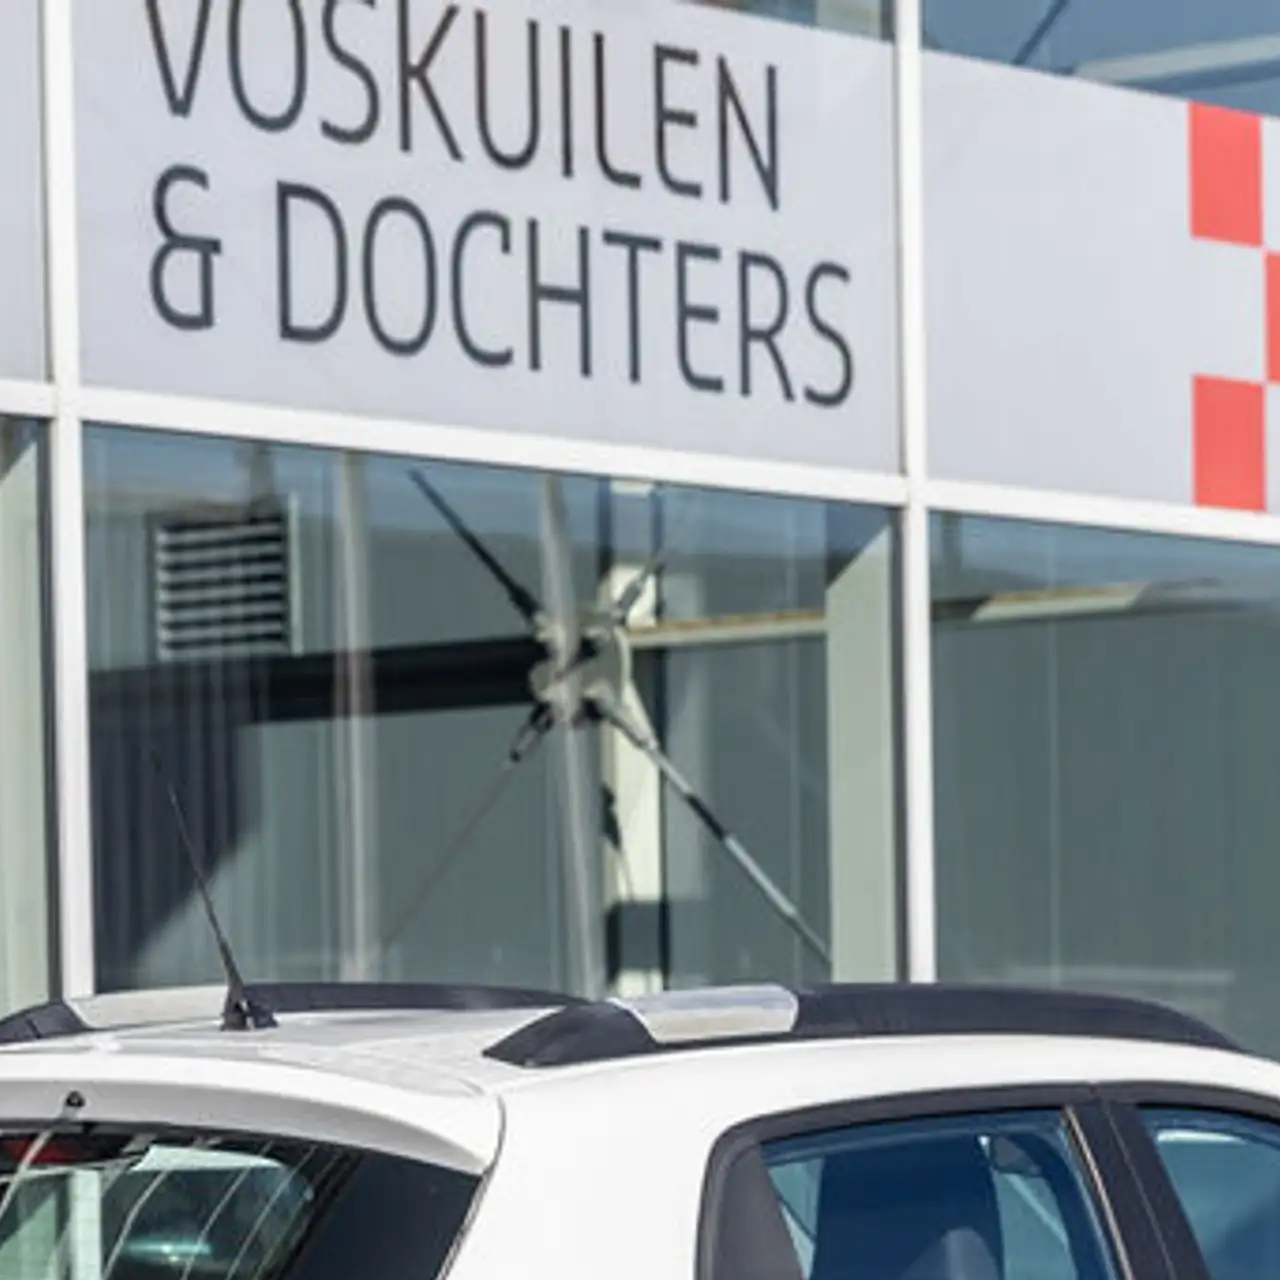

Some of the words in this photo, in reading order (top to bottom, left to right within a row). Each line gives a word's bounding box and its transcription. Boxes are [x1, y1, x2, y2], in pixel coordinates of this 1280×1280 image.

[145, 0, 780, 212] VOSKUILEN
[150, 164, 223, 331] &
[275, 180, 854, 408] DOCHTERS
